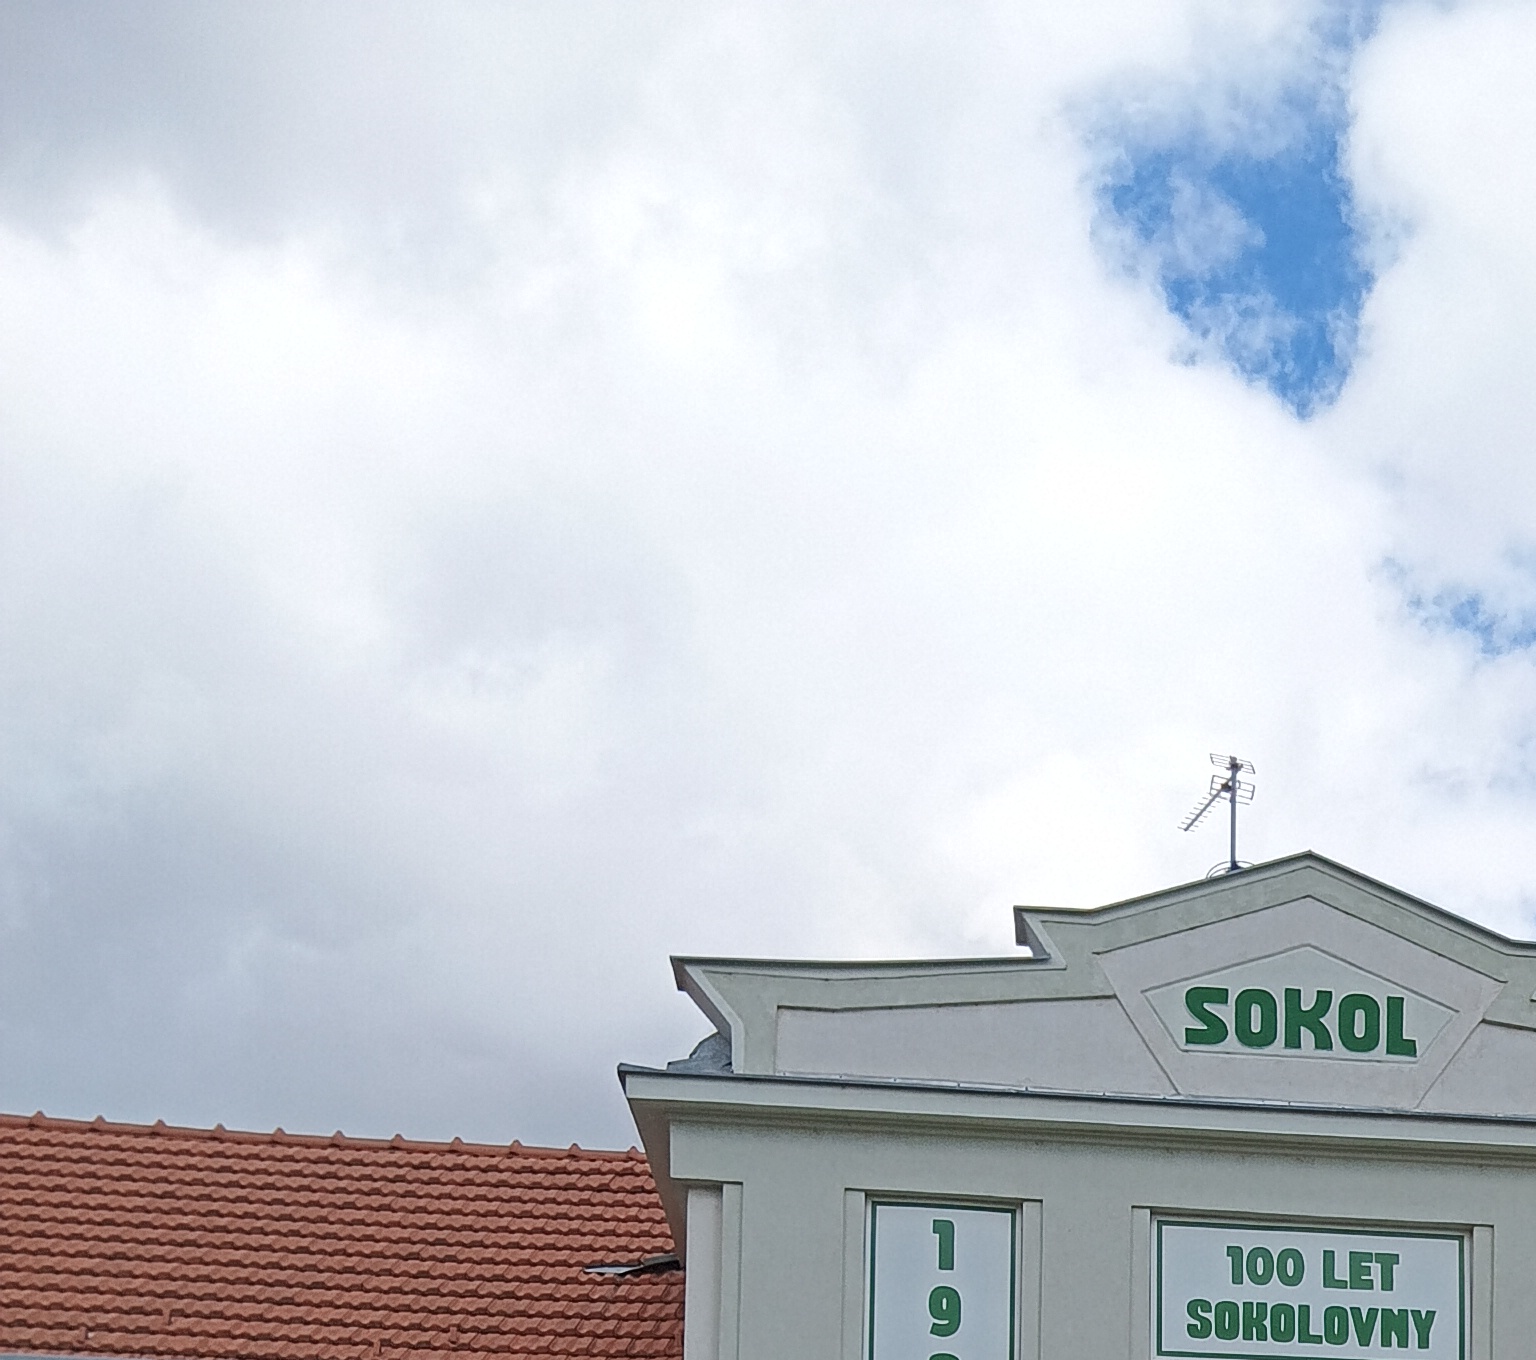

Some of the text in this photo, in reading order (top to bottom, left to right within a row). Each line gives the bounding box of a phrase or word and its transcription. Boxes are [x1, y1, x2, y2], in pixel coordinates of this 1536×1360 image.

[1184, 985, 1417, 1057] SOKOL
[1226, 1245, 1400, 1291] 100 LET
[1186, 1298, 1436, 1349] SOKOLOVNY
